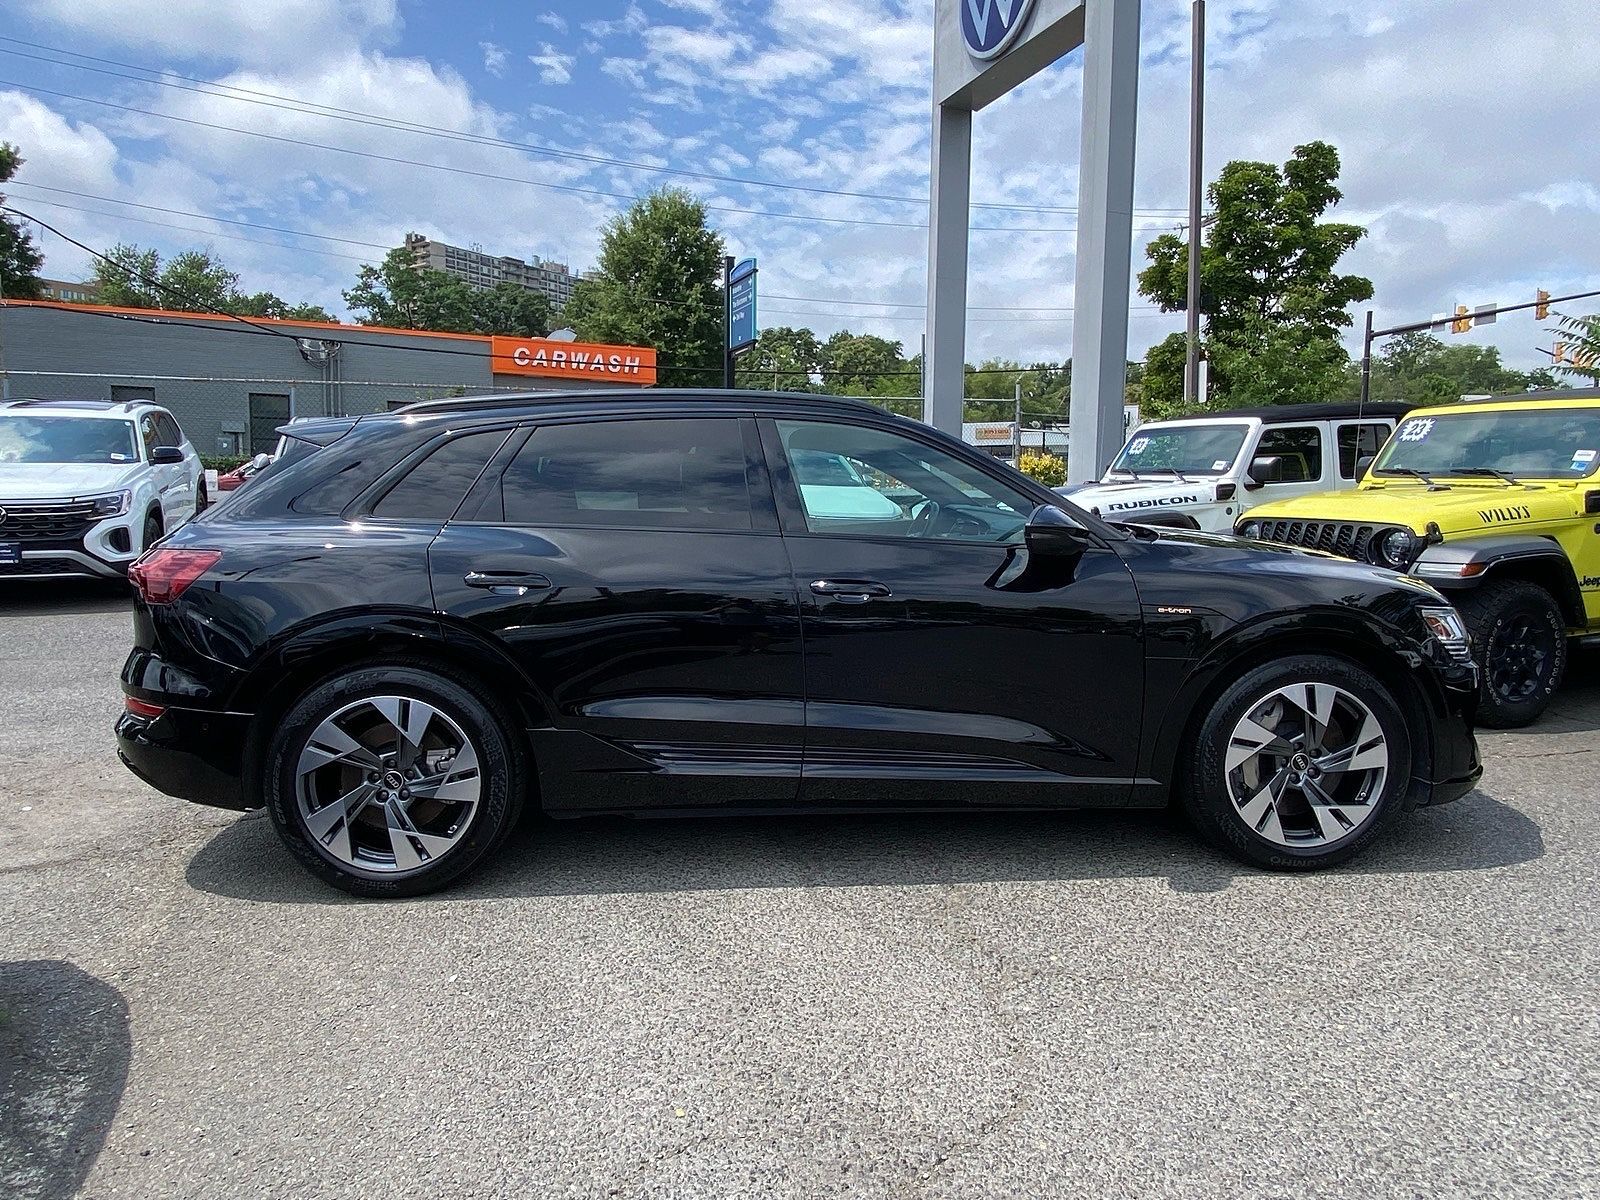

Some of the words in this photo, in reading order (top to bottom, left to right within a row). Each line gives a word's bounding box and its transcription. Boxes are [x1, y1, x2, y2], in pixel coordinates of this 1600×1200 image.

[513, 347, 640, 374] CARWASH
[1406, 423, 1426, 436] 23
[1108, 495, 1197, 511] RUBICON
[1477, 505, 1530, 523] WILLYS
[1157, 606, 1192, 614] e-tron
